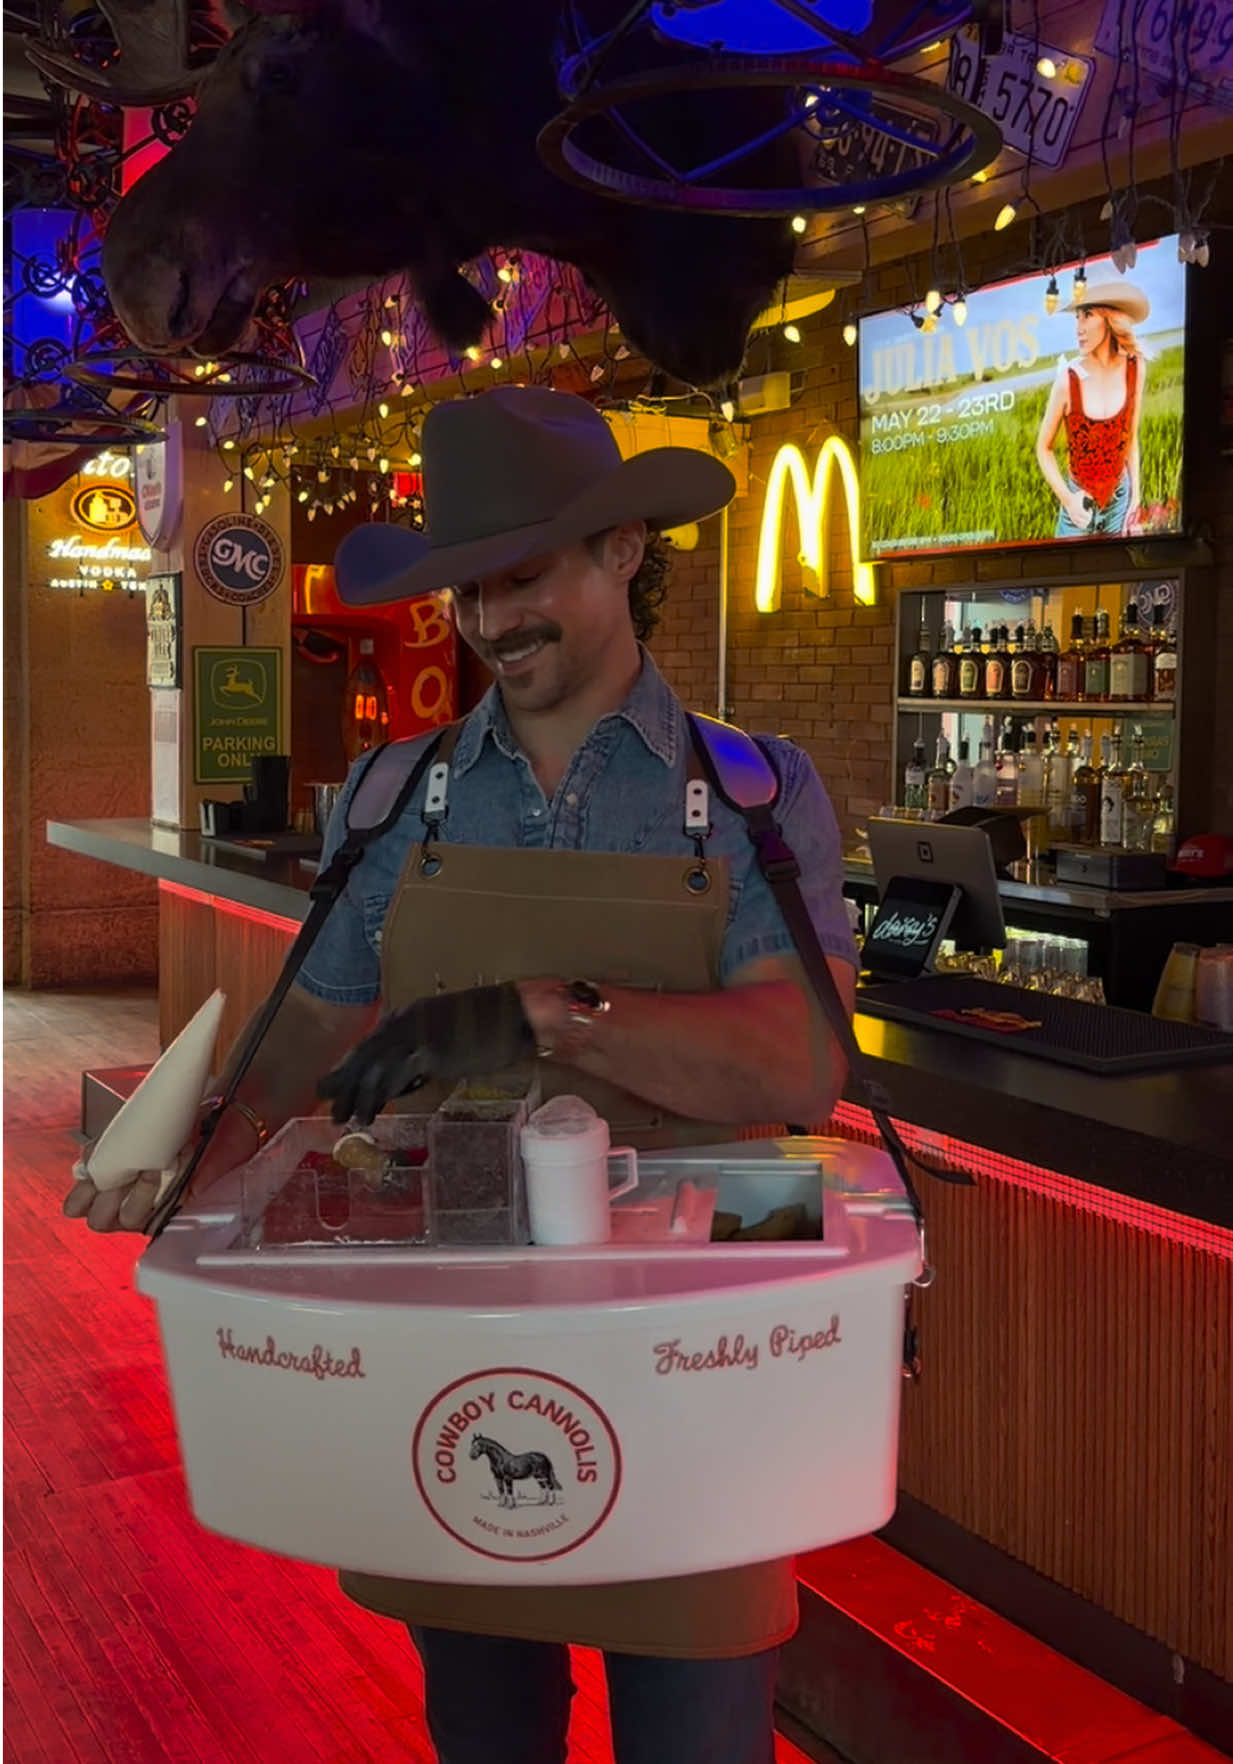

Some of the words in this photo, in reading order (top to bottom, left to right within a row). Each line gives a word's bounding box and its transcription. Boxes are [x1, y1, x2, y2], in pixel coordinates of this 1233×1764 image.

[993, 70, 1069, 146] 5770
[864, 333, 959, 406] JULIA
[967, 314, 1042, 382] VOS
[871, 408, 914, 434] MAY
[917, 403, 942, 427] 22
[958, 389, 1016, 419] 23RD
[78, 565, 137, 578] VODKA
[212, 538, 268, 581] GMC
[49, 578, 98, 589] AUSTIN
[120, 580, 148, 591] TEX
[201, 735, 276, 752] PARKING
[216, 752, 262, 769] ONL
[215, 1326, 367, 1381] Handcrafted
[652, 1333, 759, 1376] Freshly
[769, 1314, 842, 1362] Piped
[434, 1391, 496, 1485] COWBOY
[506, 1389, 598, 1484] CANNOLIS
[472, 1515, 500, 1536] MADE
[502, 1528, 515, 1538] IN
[517, 1513, 570, 1538] NASHVILLE
